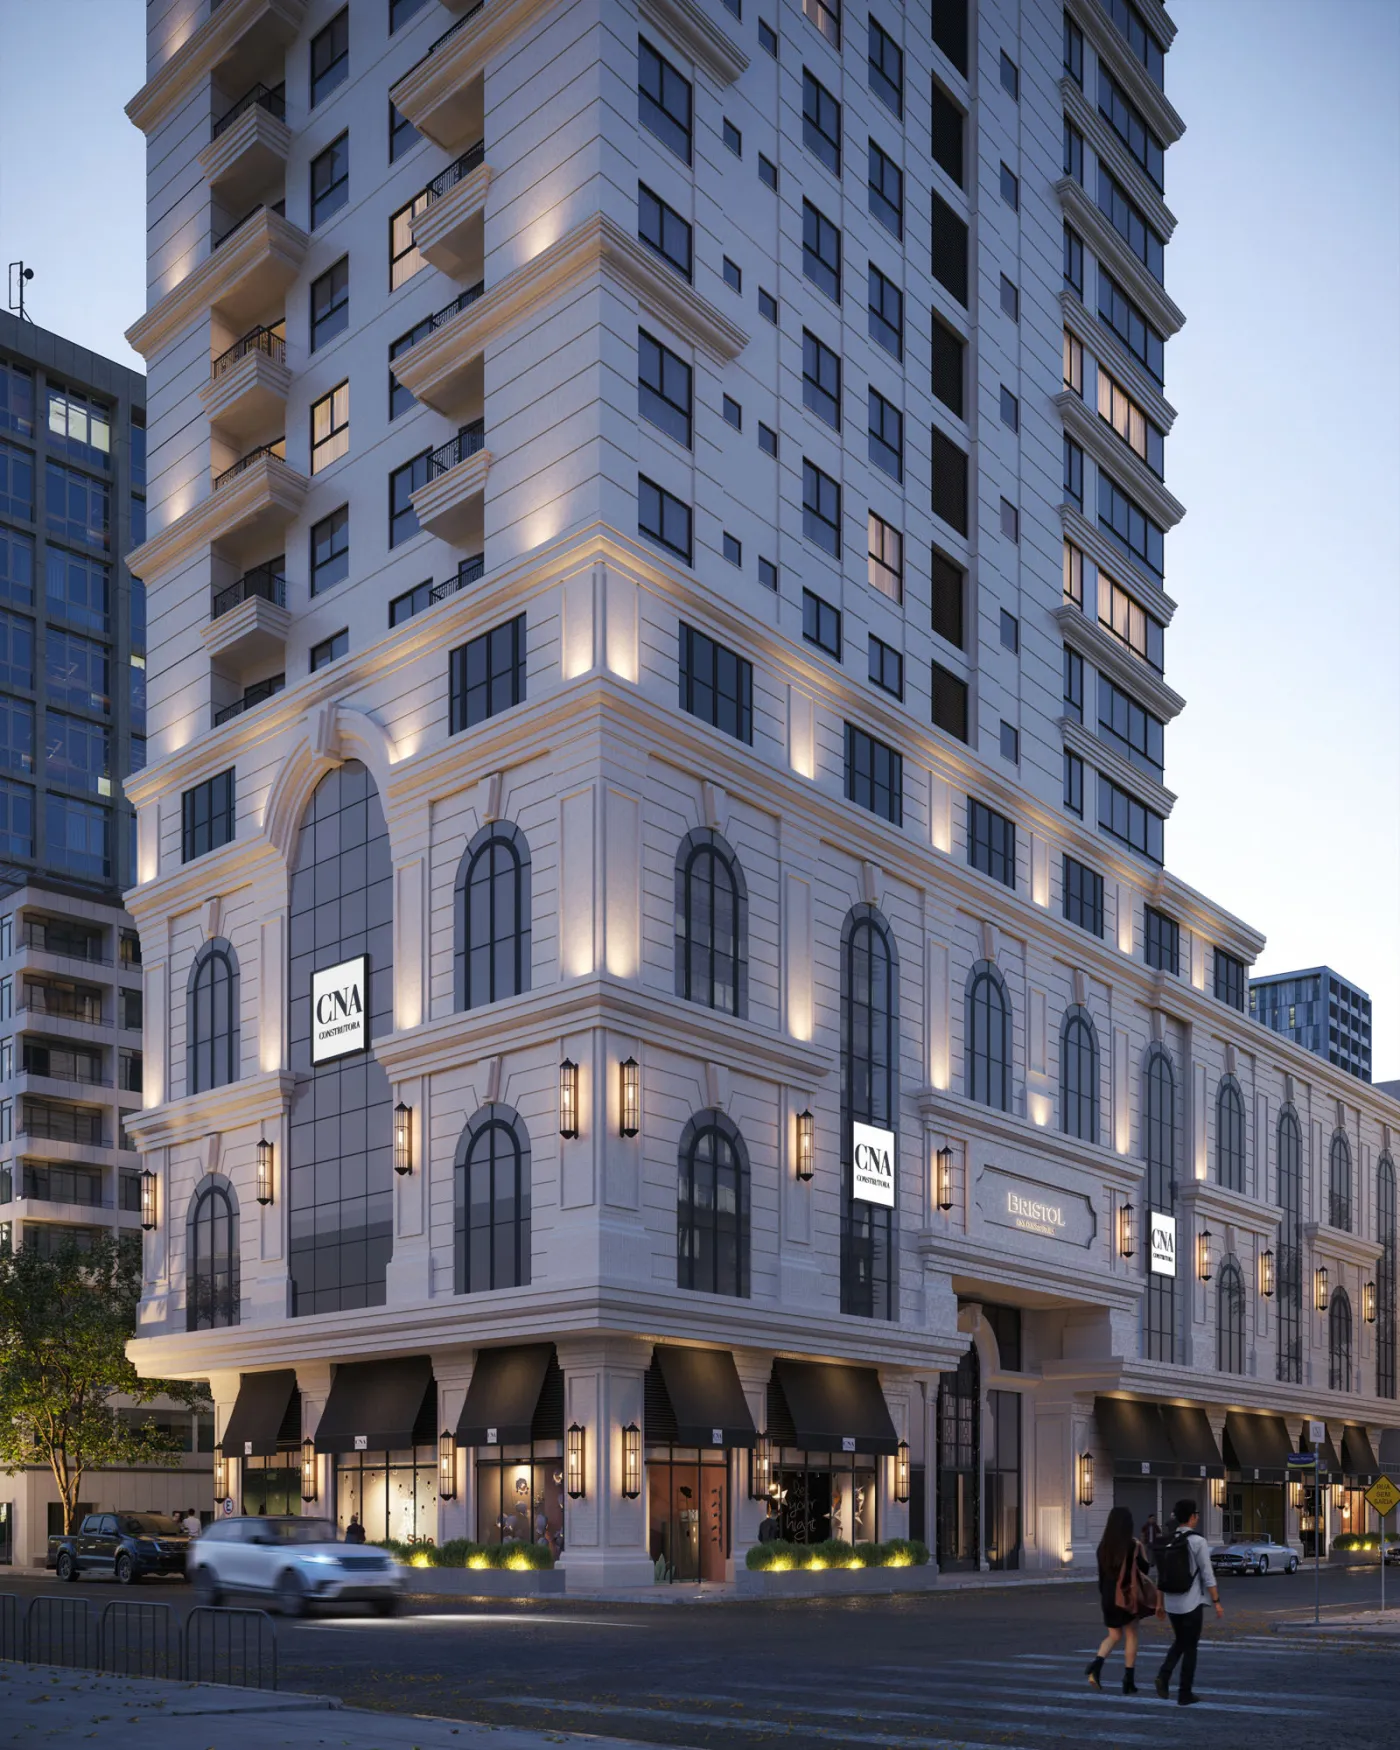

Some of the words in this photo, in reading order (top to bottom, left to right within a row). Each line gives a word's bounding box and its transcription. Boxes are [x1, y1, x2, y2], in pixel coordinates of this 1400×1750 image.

[316, 984, 363, 1025] CNA
[318, 1021, 361, 1040] CONSTRUTORA
[854, 1143, 892, 1177] CNA
[1007, 1192, 1065, 1227] BRISTOL
[1152, 1228, 1174, 1253] CNA
